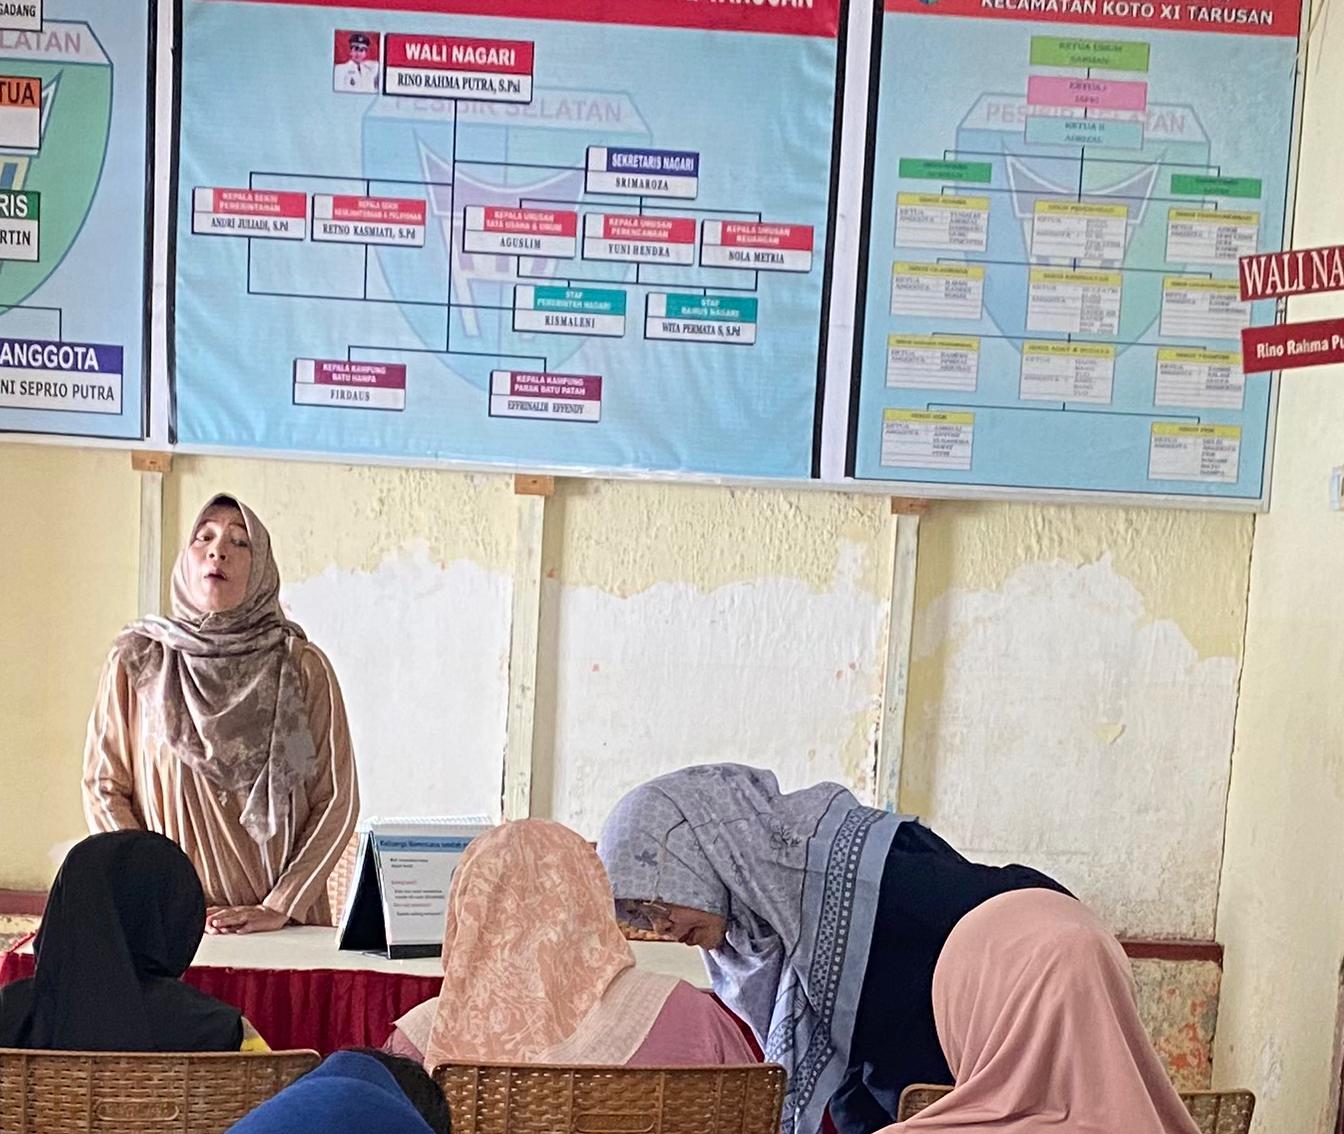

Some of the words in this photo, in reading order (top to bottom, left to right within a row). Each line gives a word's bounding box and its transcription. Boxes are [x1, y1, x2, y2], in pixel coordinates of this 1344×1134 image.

[1103, 4, 1154, 18] KOTO
[1160, 7, 1180, 20] XI
[1188, 7, 1274, 25] TARUSAN
[405, 42, 447, 62] WALI
[452, 45, 515, 66] NAGARI
[397, 72, 423, 87] RINO
[424, 74, 460, 89] RAHMA
[462, 77, 497, 94] PUTRA,
[612, 153, 661, 169] SEKRETARIS
[663, 156, 694, 171] NAGARI
[616, 177, 668, 190] SRIMAROZA
[323, 223, 350, 235] RETNO
[500, 236, 541, 249] AGUSLIM
[608, 243, 630, 255] YUNI
[632, 245, 670, 257] HENDRA
[728, 250, 751, 262] NOLA
[1241, 252, 1305, 298] WALI
[545, 315, 596, 329] RISMALENI
[1256, 342, 1285, 359] Rino
[1287, 338, 1329, 355] Rahma
[516, 375, 545, 384] KEPALA
[19, 380, 69, 398] SEPRIO
[72, 382, 115, 402] PUTRA
[330, 389, 370, 401] FIRDAUS
